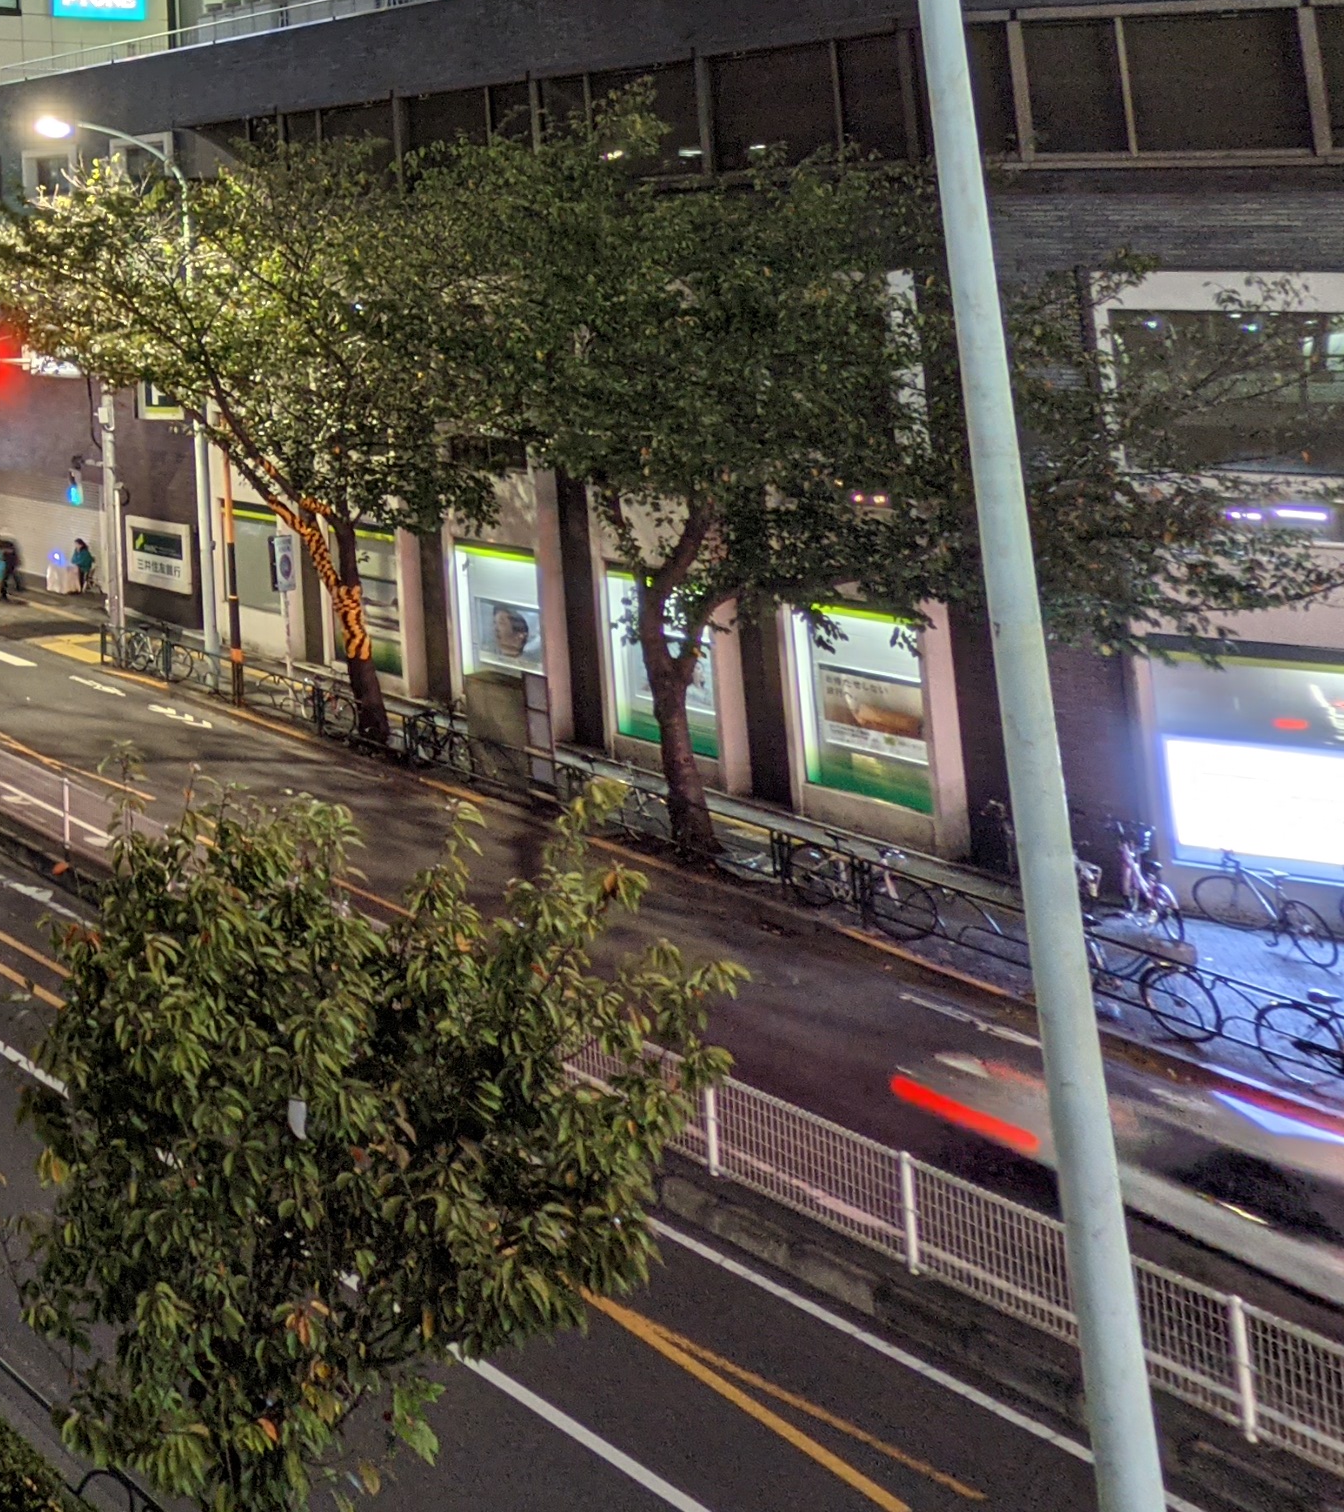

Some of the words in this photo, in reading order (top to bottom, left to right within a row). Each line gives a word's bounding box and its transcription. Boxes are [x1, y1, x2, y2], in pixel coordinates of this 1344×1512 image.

[137, 558, 181, 578] 三井住友銀行
